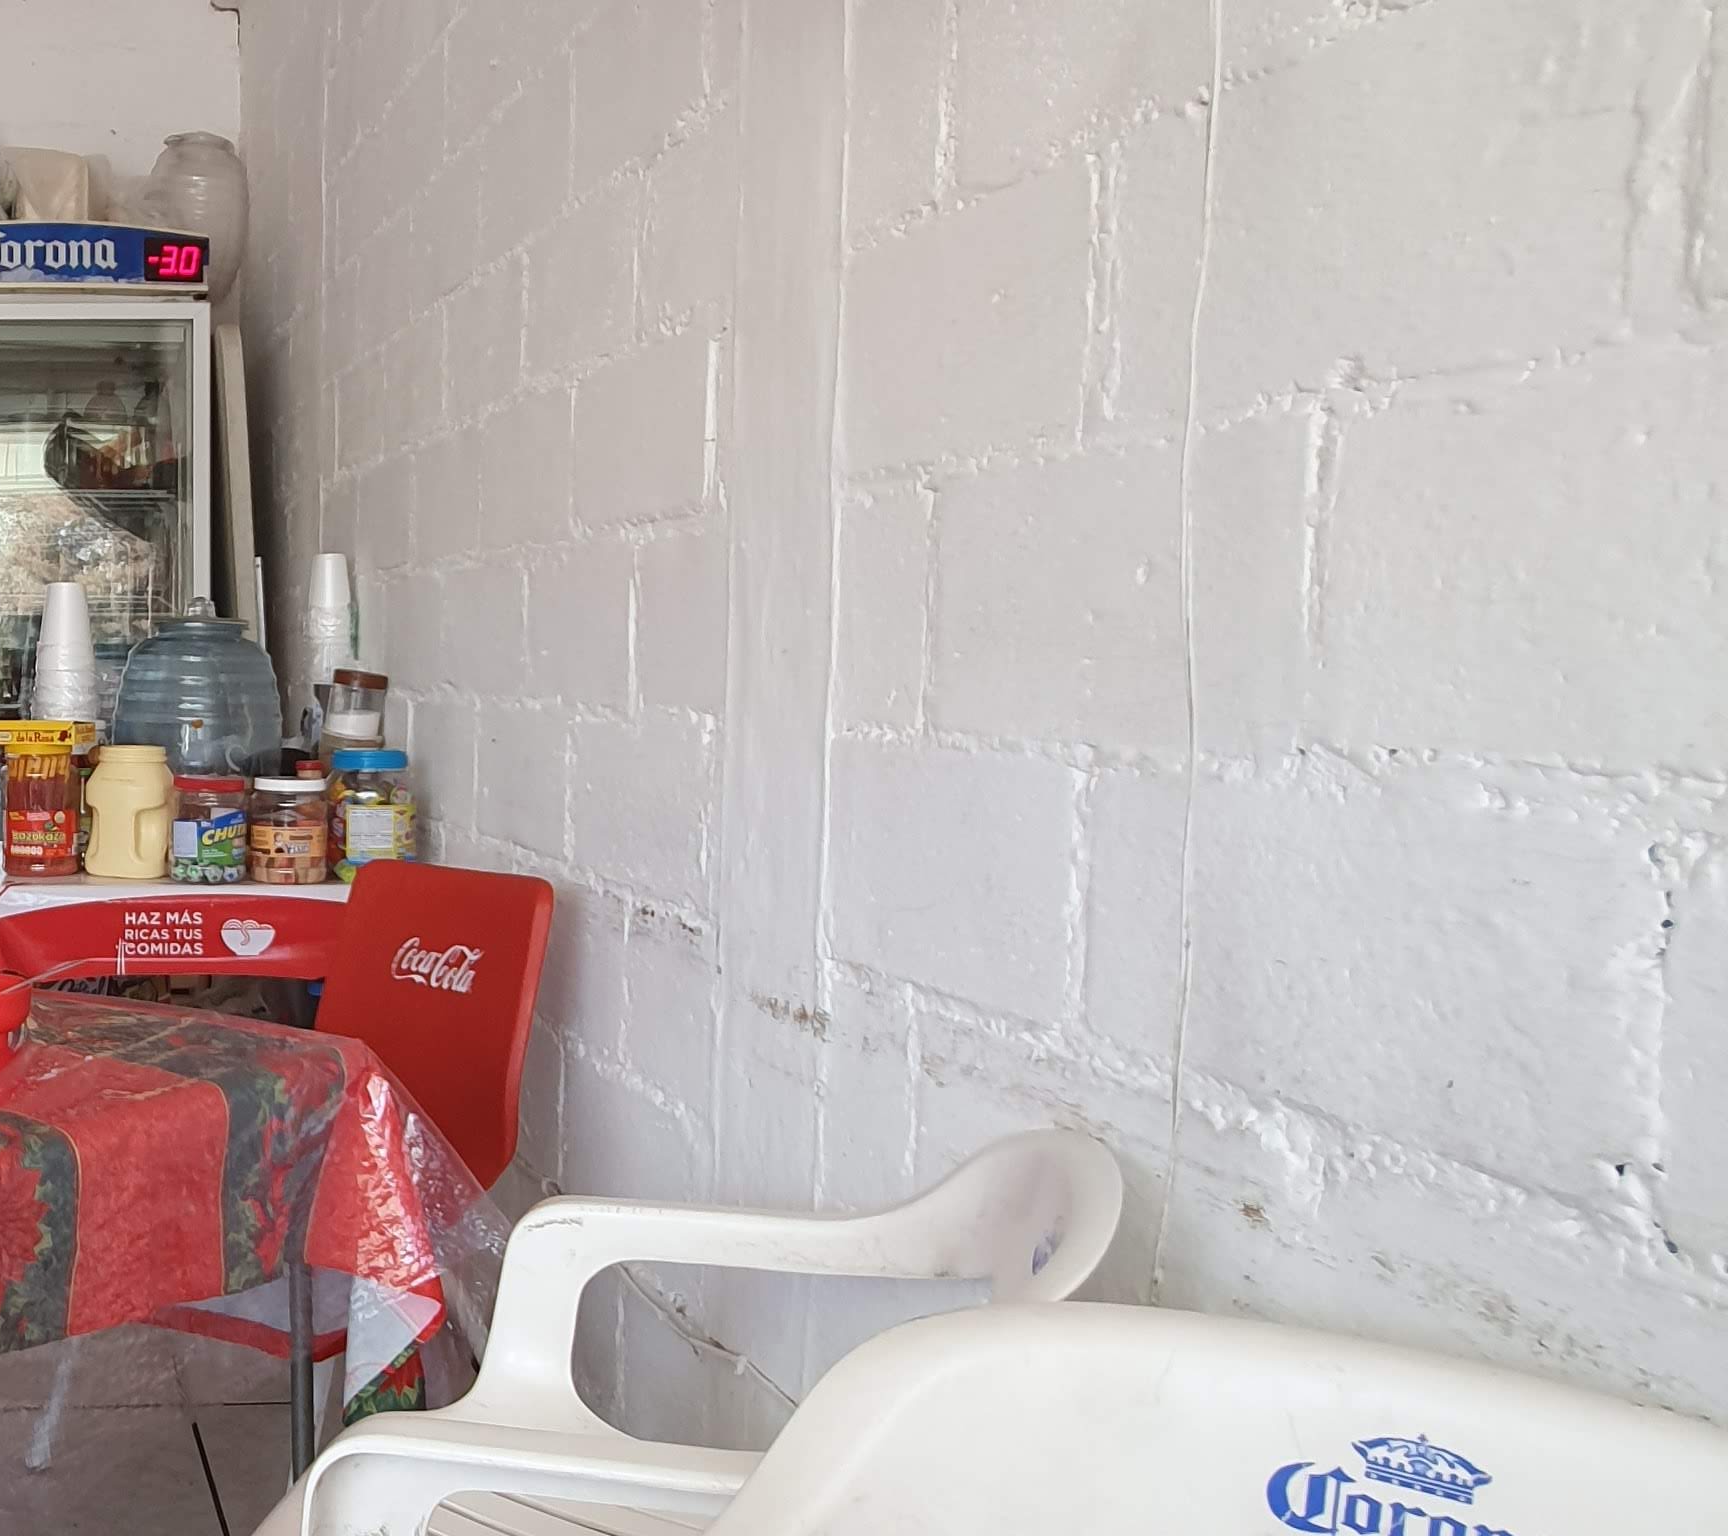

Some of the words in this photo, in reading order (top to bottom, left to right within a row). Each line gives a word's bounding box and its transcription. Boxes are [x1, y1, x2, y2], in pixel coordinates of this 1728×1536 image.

[125, 912, 161, 925] HAZ
[166, 909, 203, 925] MÁS
[125, 929, 170, 940] RICAS
[174, 929, 203, 940] TUS
[125, 943, 204, 955] COMIDAS
